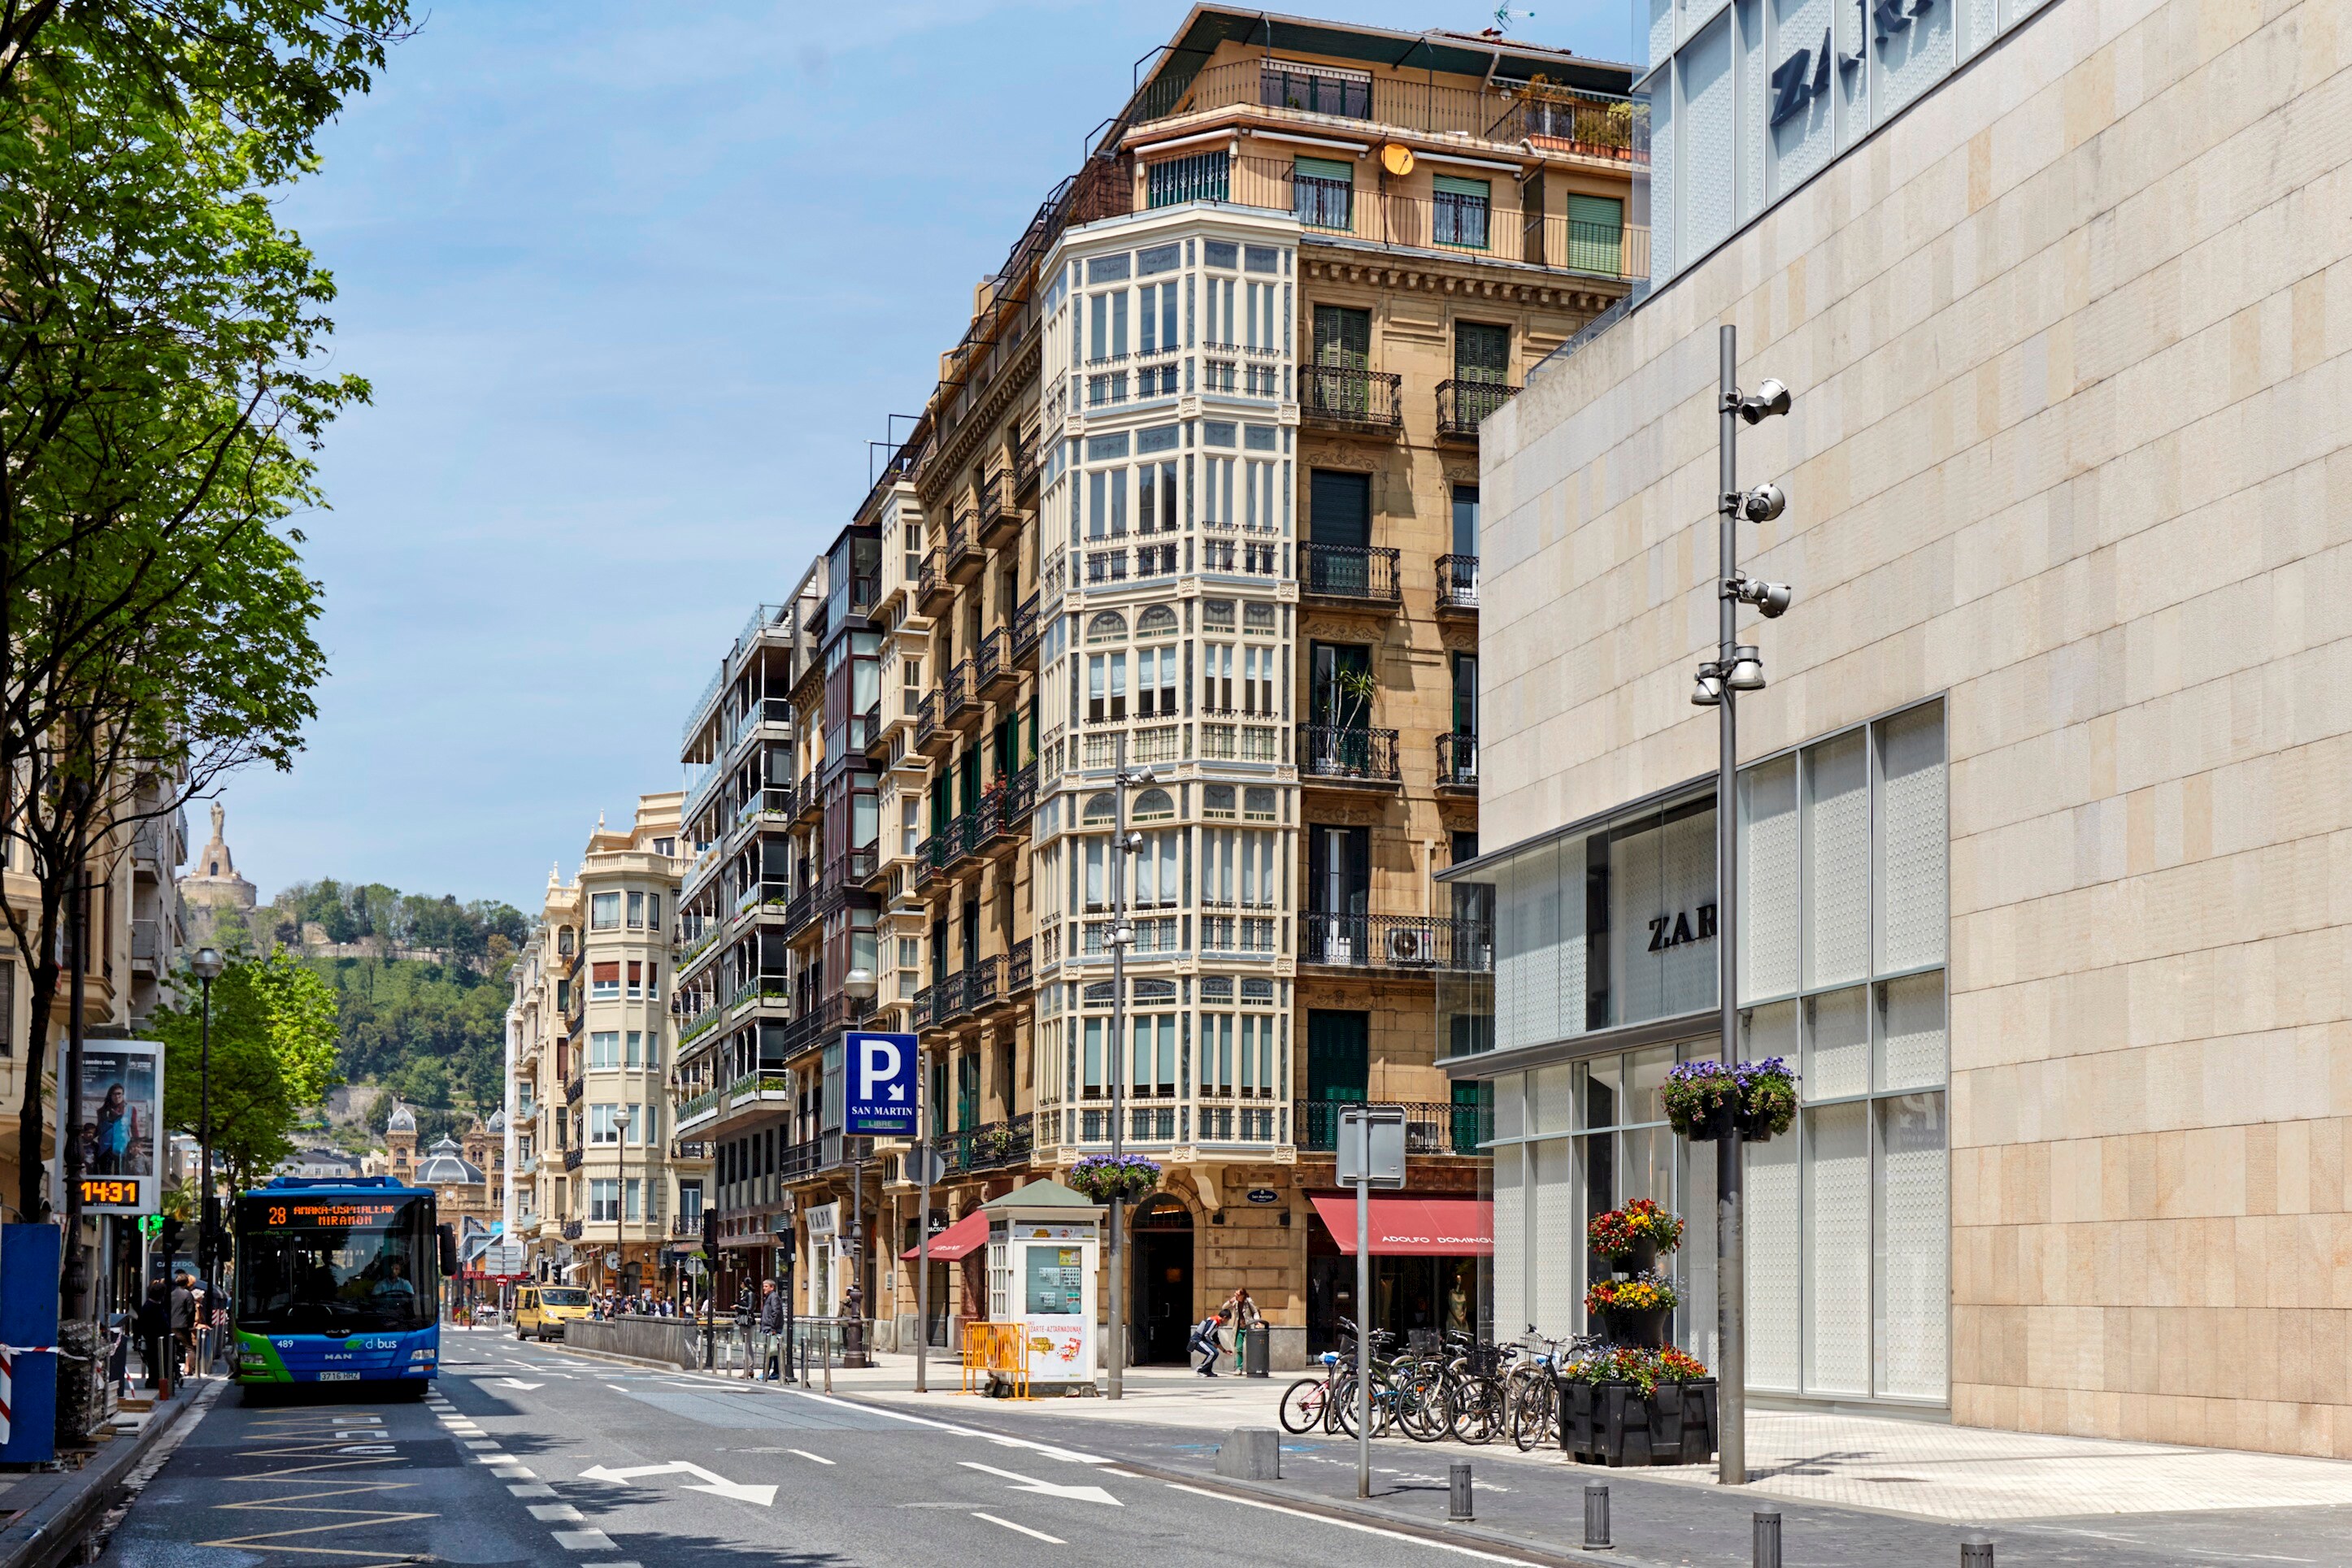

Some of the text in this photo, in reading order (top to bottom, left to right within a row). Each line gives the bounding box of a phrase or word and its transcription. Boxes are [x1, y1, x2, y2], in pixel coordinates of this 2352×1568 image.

[852, 1106, 912, 1116] SAN MARTIN
[80, 1182, 136, 1202] 14:31
[269, 1207, 286, 1225] 28
[319, 1216, 372, 1226] MIRAMON
[277, 1340, 293, 1349] 489
